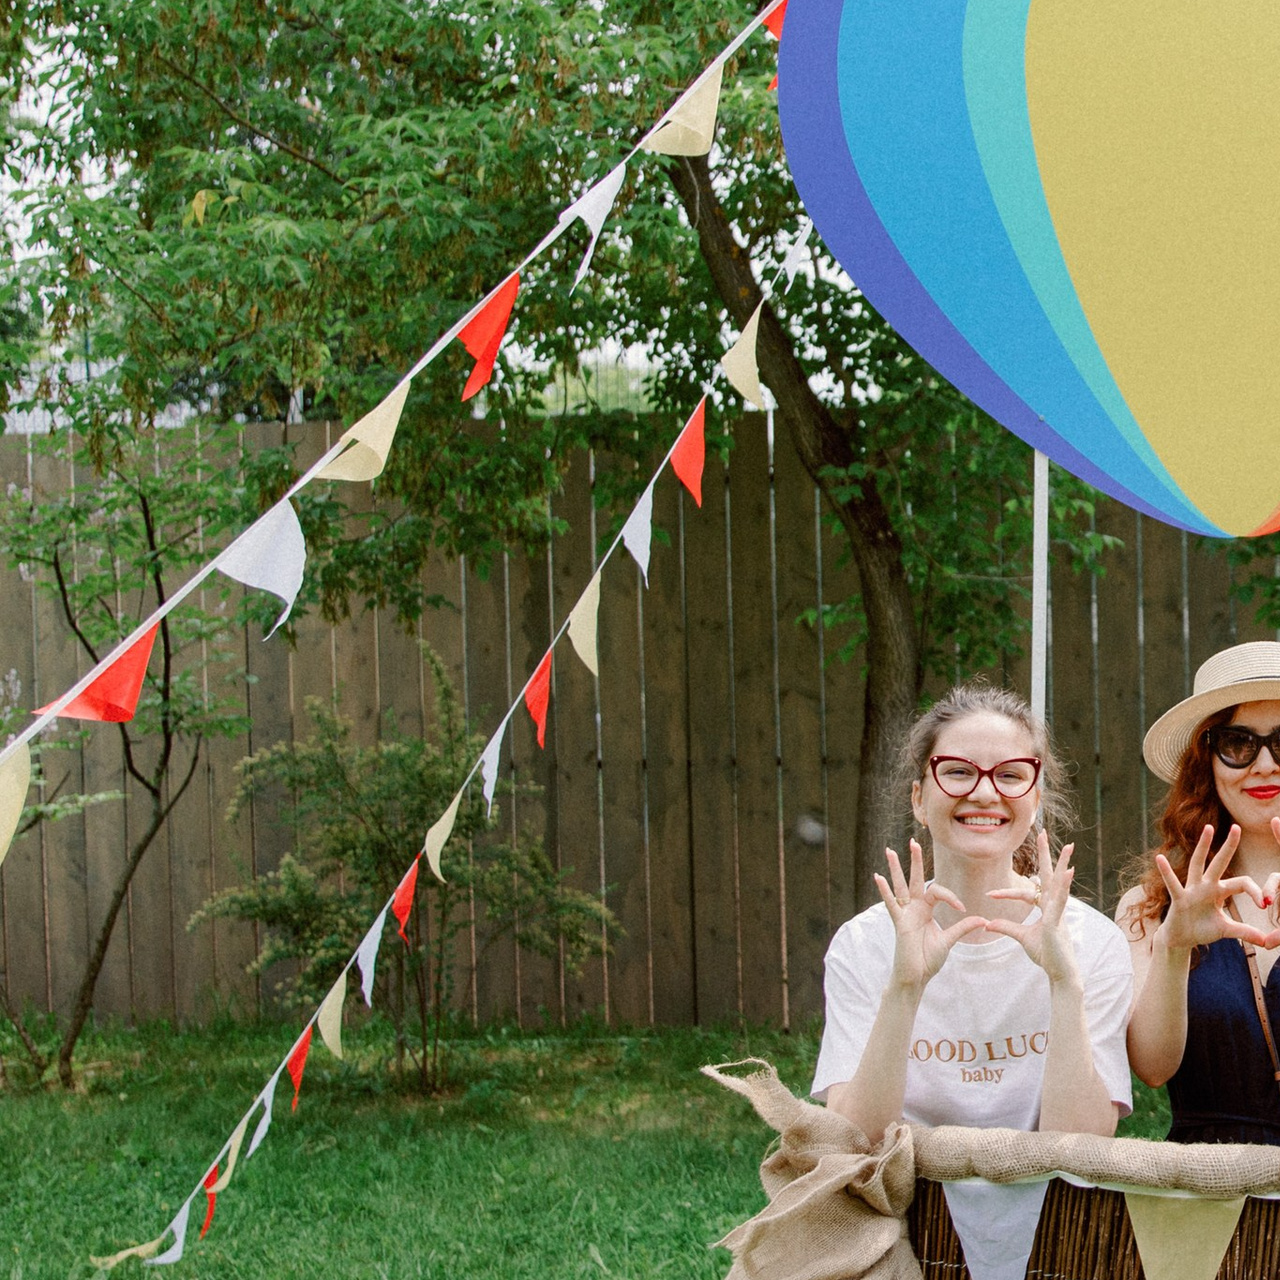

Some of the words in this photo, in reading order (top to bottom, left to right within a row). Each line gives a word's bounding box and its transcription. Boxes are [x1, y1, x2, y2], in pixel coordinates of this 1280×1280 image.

[908, 1038, 977, 1063] OOD
[984, 1030, 1050, 1061] LUC
[960, 1066, 1005, 1084] baby
